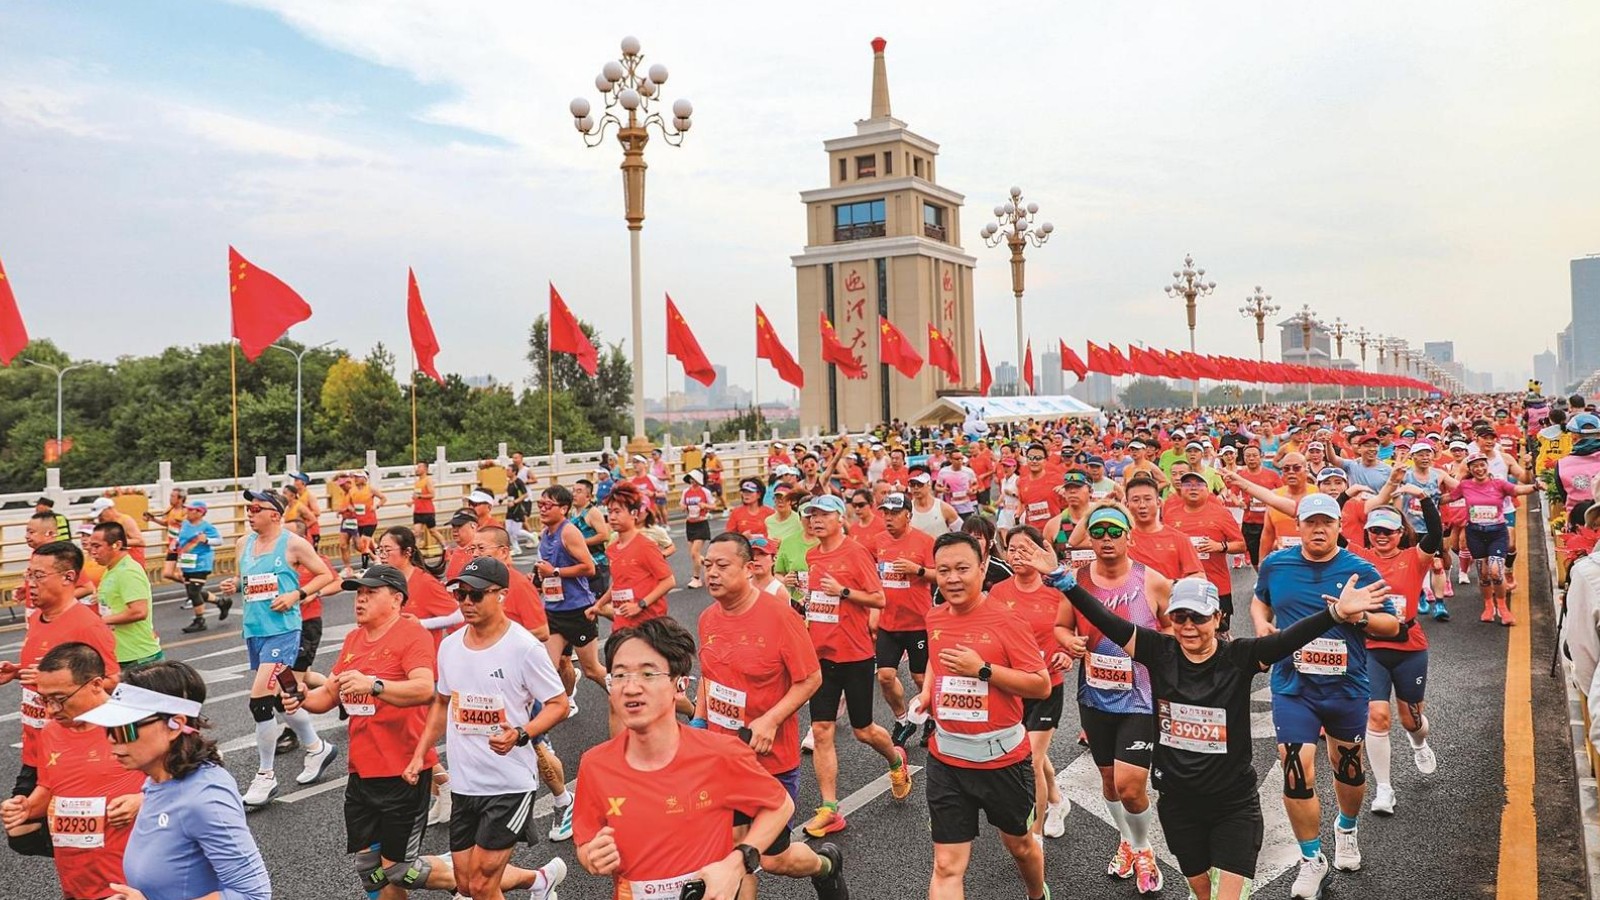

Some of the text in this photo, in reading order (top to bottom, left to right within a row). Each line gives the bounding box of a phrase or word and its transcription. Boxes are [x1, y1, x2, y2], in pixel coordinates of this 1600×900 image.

[810, 602, 835, 613] 32307
[1305, 652, 1343, 665] 30488
[1093, 667, 1127, 682] 33364
[709, 697, 740, 719] 33363
[942, 693, 983, 709] 29805
[462, 709, 500, 724] 34408
[1161, 718, 1219, 740] G 39094
[56, 816, 97, 833] 32930
